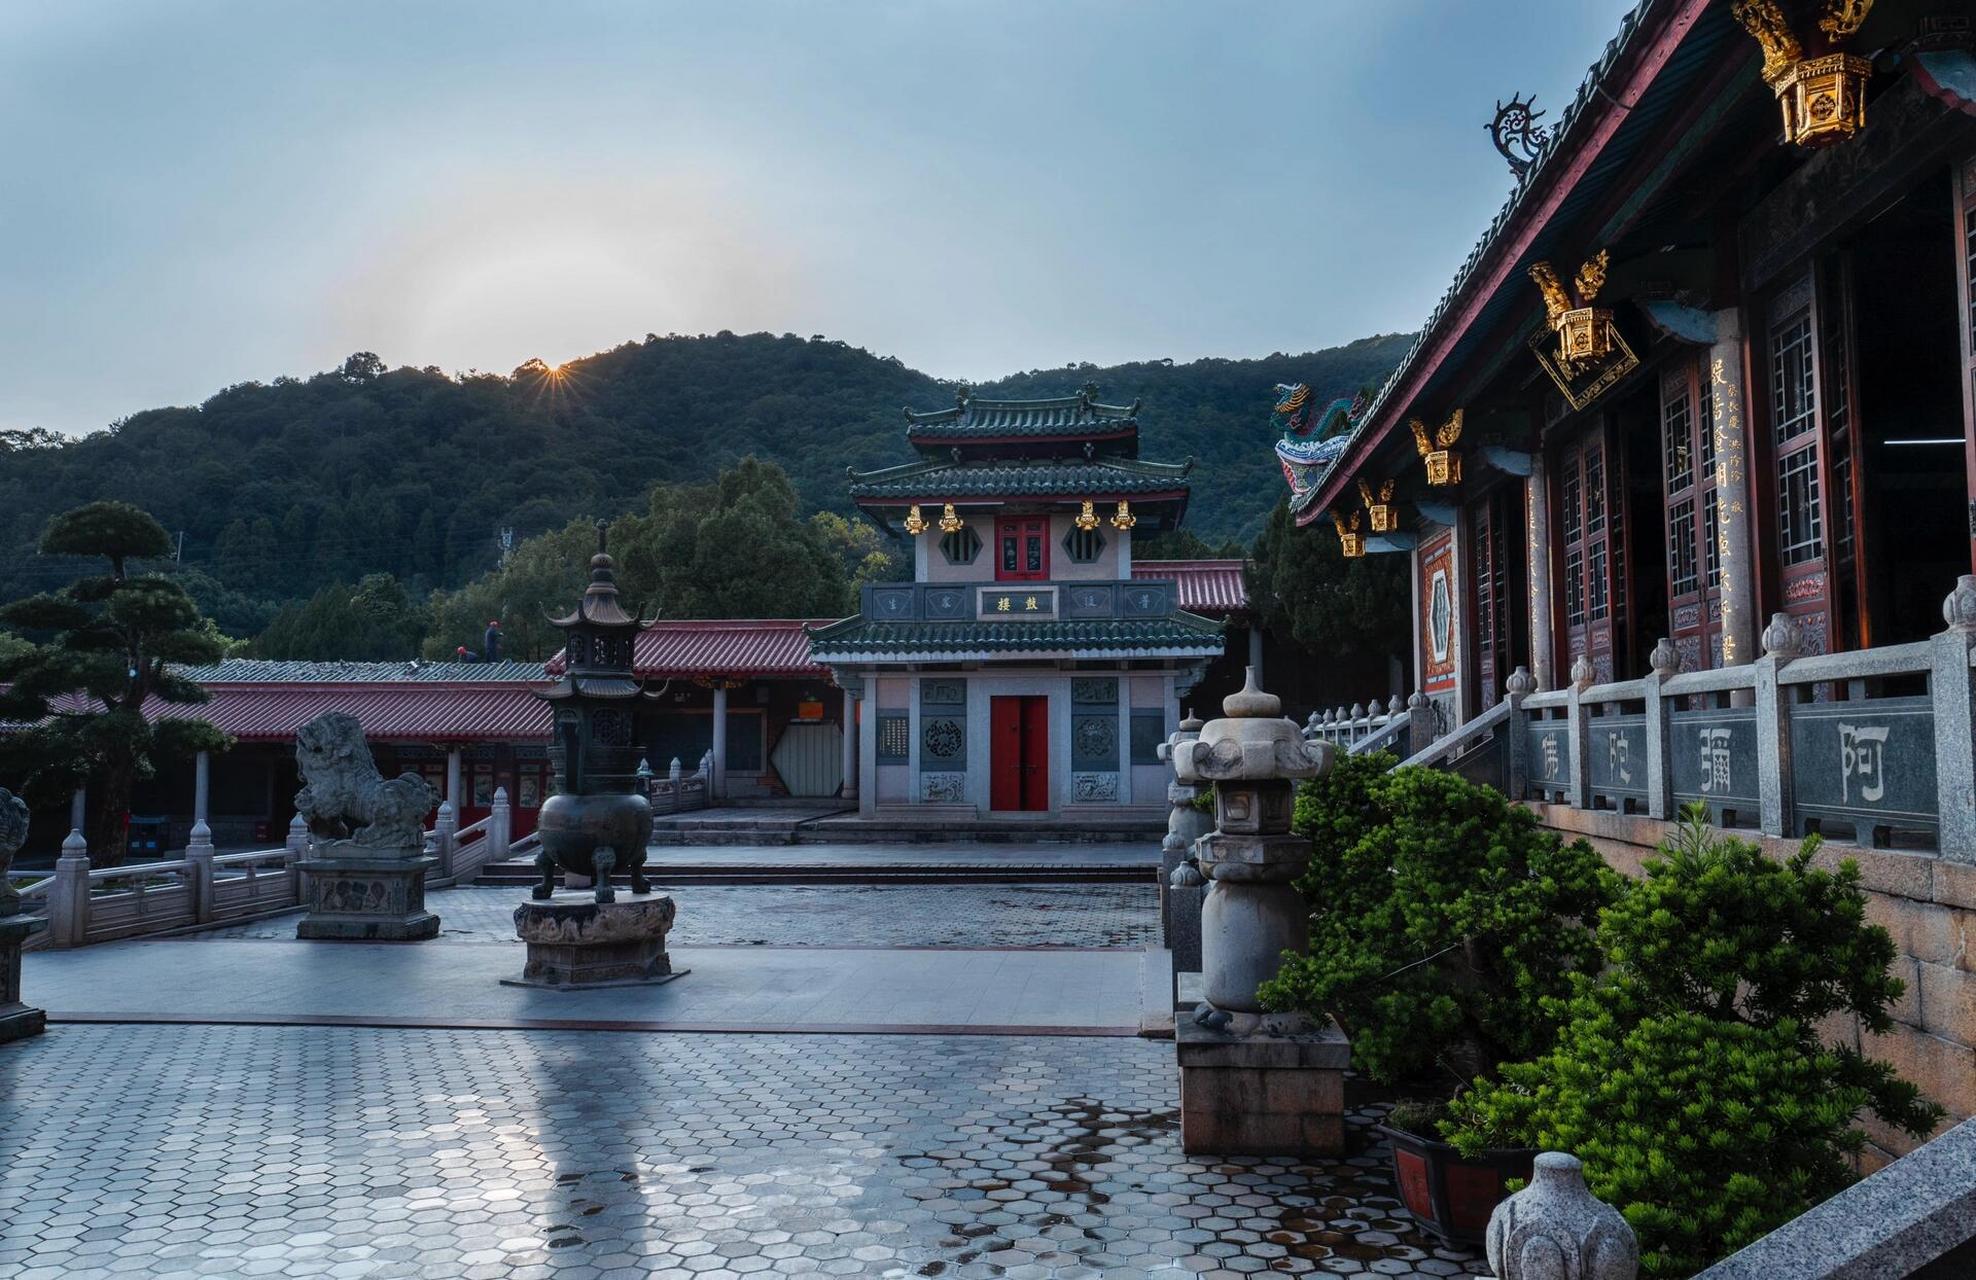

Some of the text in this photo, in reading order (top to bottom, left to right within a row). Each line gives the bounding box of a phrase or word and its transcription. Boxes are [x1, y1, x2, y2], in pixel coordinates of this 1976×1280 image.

[1541, 721, 1890, 804] 阿 彌 陀 佛
